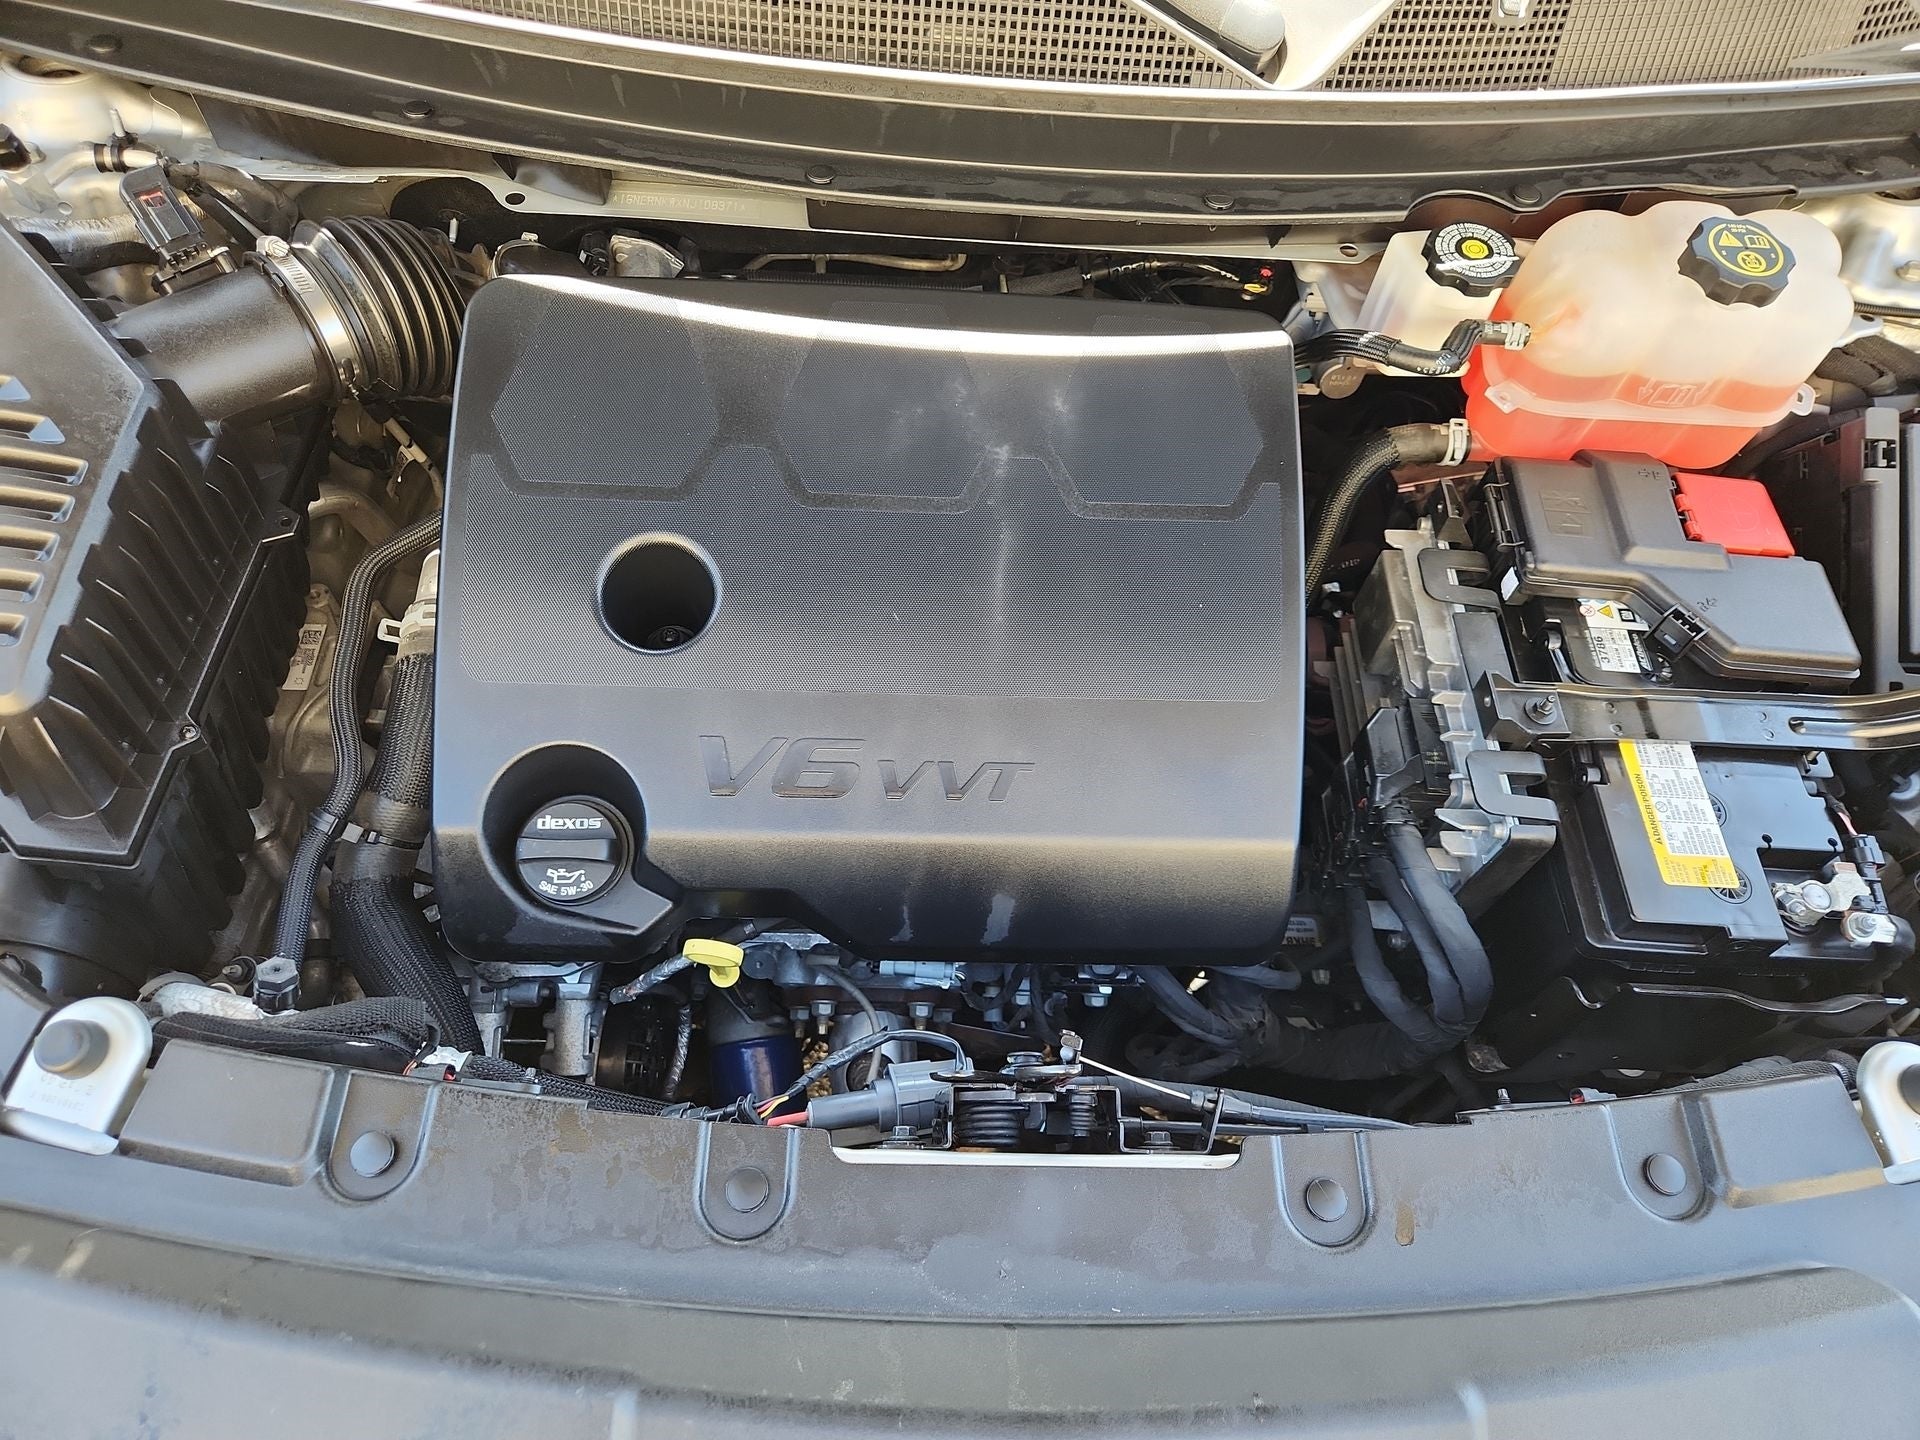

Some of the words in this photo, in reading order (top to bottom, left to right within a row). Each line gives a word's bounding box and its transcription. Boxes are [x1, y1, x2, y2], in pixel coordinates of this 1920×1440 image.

[1594, 636, 1610, 663] 3786
[699, 735, 867, 799] V6
[877, 759, 1036, 802] VVT
[536, 814, 604, 830] dexos
[539, 880, 559, 895] SAE
[560, 880, 594, 896] 5W-30
